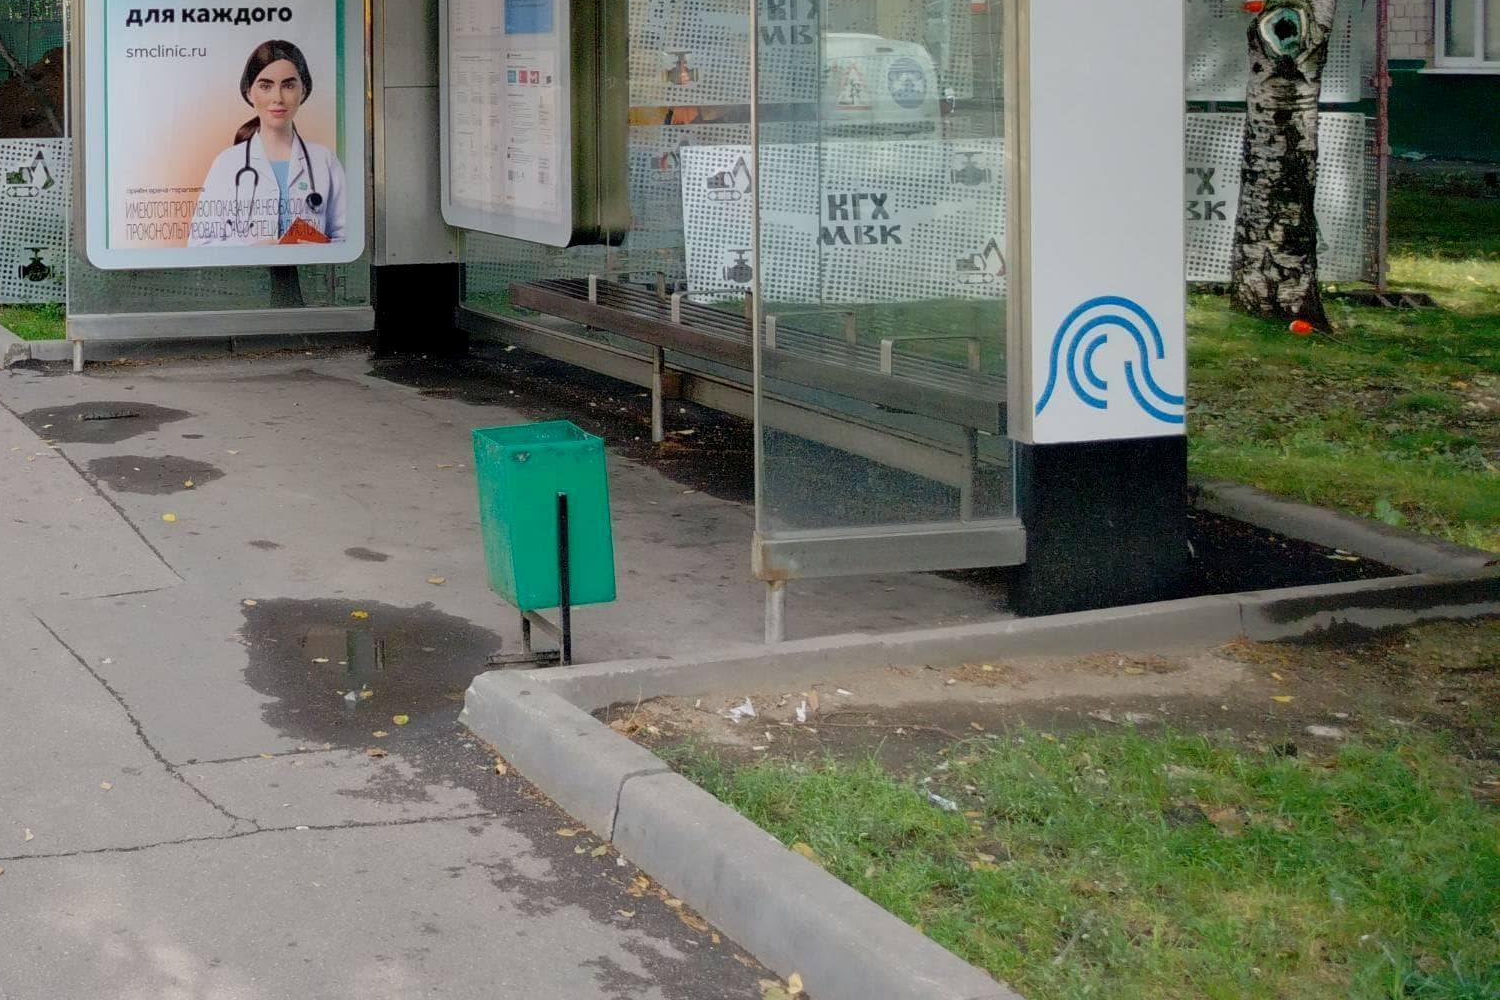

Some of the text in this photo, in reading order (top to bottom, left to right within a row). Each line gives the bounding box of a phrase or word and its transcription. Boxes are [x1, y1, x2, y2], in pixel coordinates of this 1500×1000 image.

[126, 6, 293, 27] для каждого
[126, 44, 207, 59] smclinic.ru
[827, 193, 890, 221] КГХ
[1185, 200, 1227, 221] ВК
[816, 224, 902, 246] МВК
